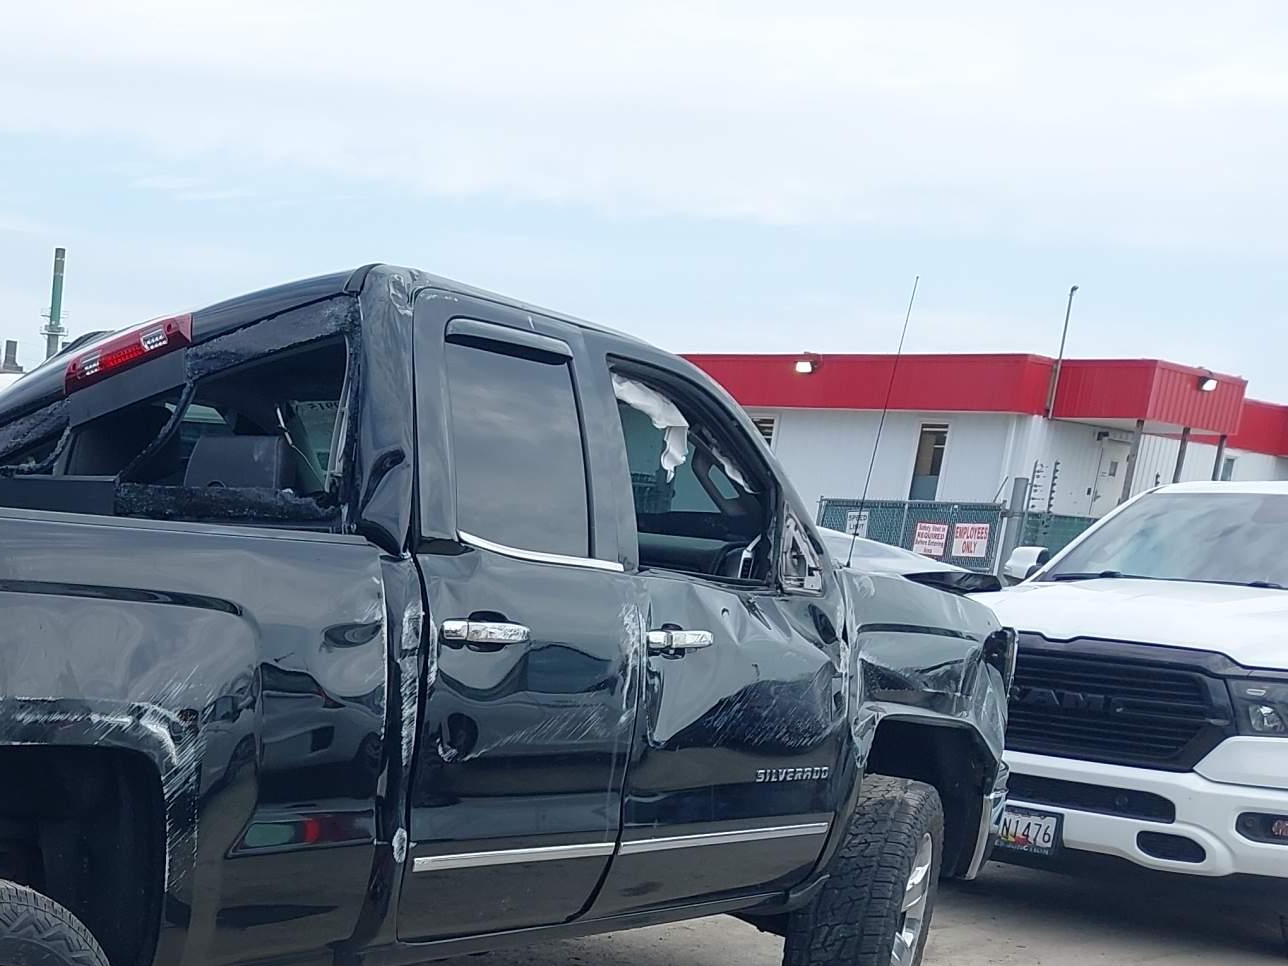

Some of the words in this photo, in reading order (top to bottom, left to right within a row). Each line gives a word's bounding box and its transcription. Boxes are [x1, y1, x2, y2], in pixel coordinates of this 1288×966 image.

[955, 527, 988, 540] EMPLOYEES
[961, 541, 977, 553] ONLY
[755, 766, 829, 782] SILVERADO
